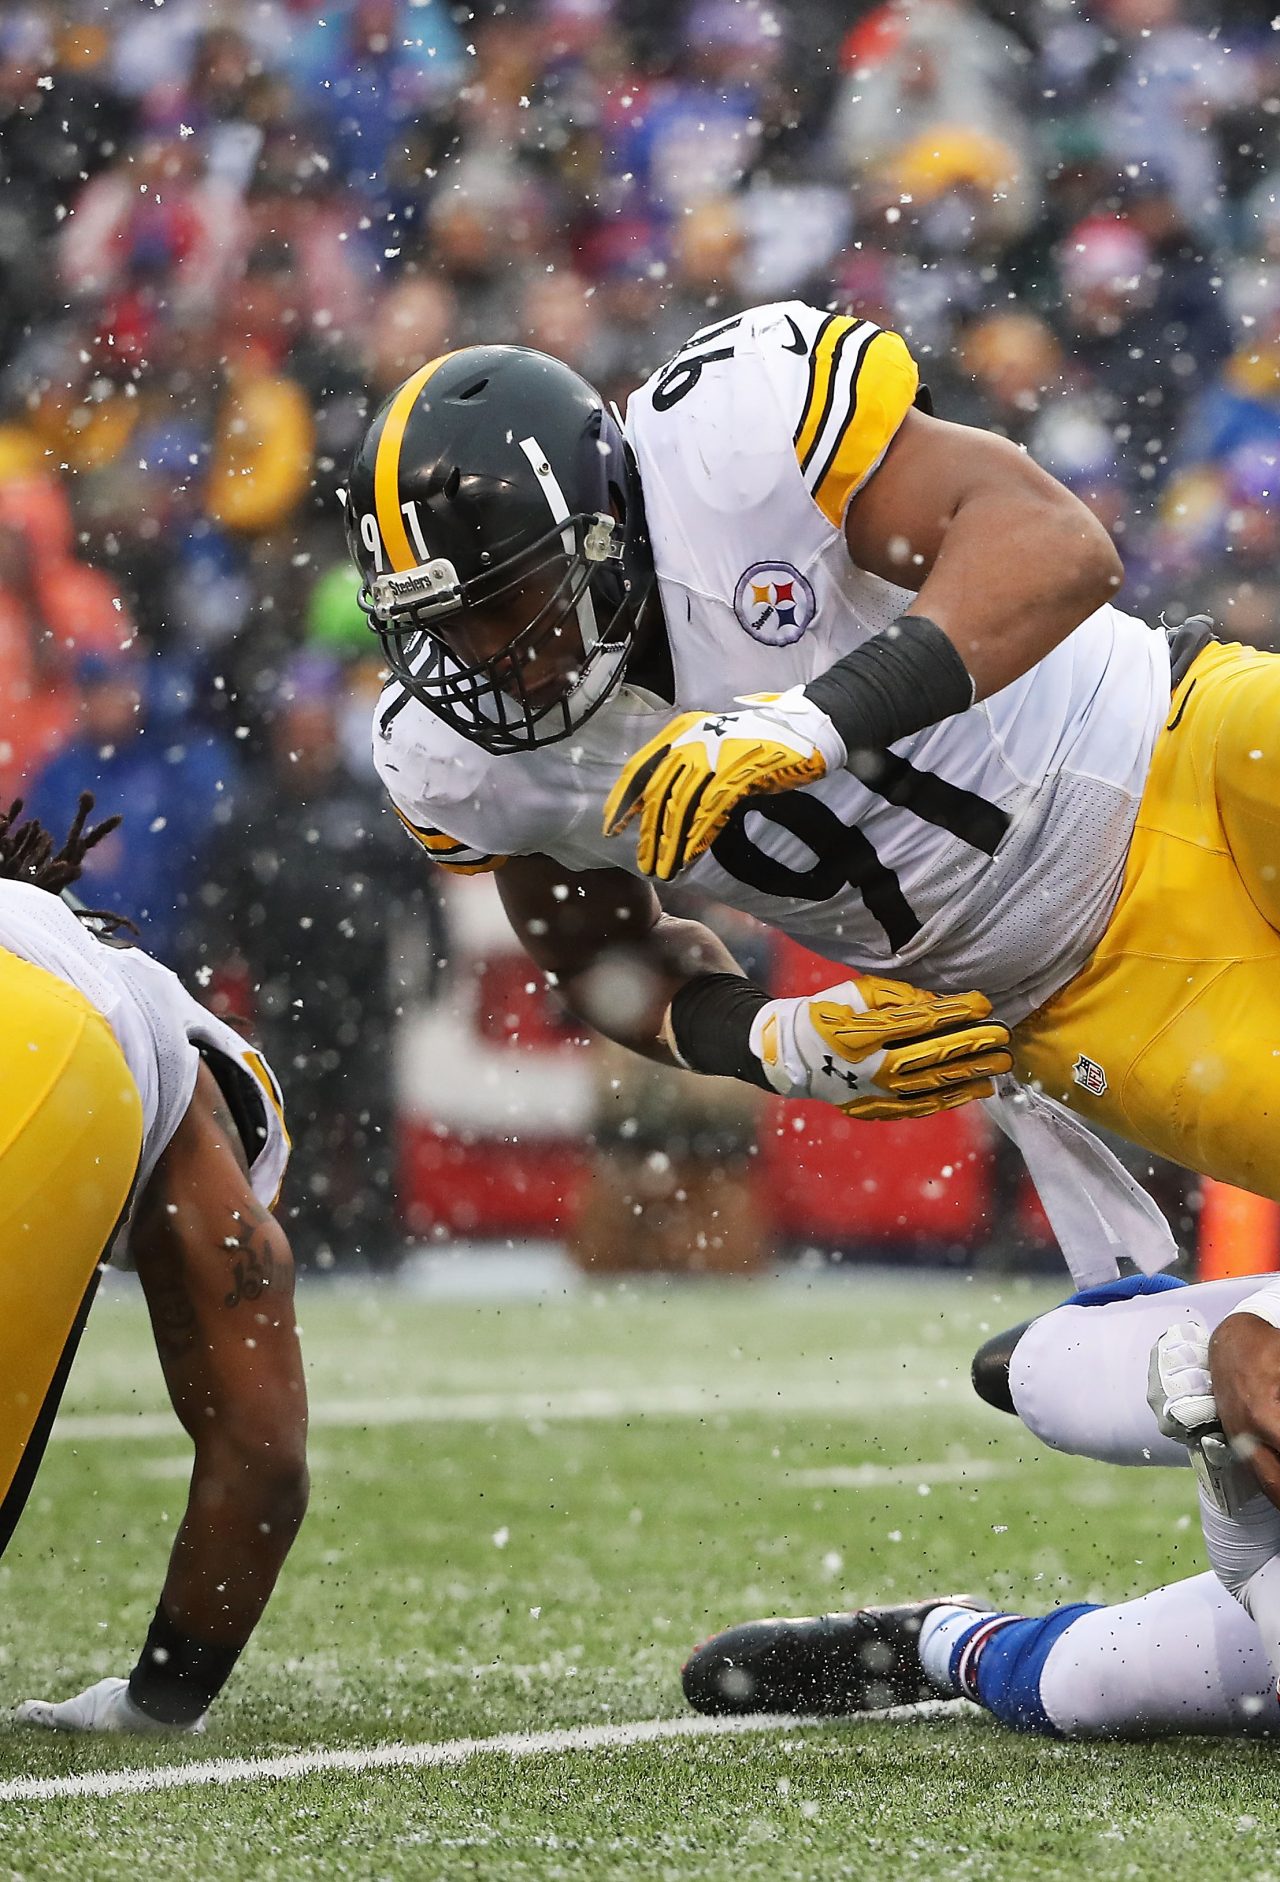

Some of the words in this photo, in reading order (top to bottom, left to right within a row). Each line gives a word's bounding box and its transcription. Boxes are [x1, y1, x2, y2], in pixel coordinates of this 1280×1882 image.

[361, 500, 431, 573] 91
[388, 575, 432, 596] Steelers
[751, 605, 775, 631] Steelers
[710, 747, 1014, 956] 91
[1086, 1064, 1103, 1091] NFL
